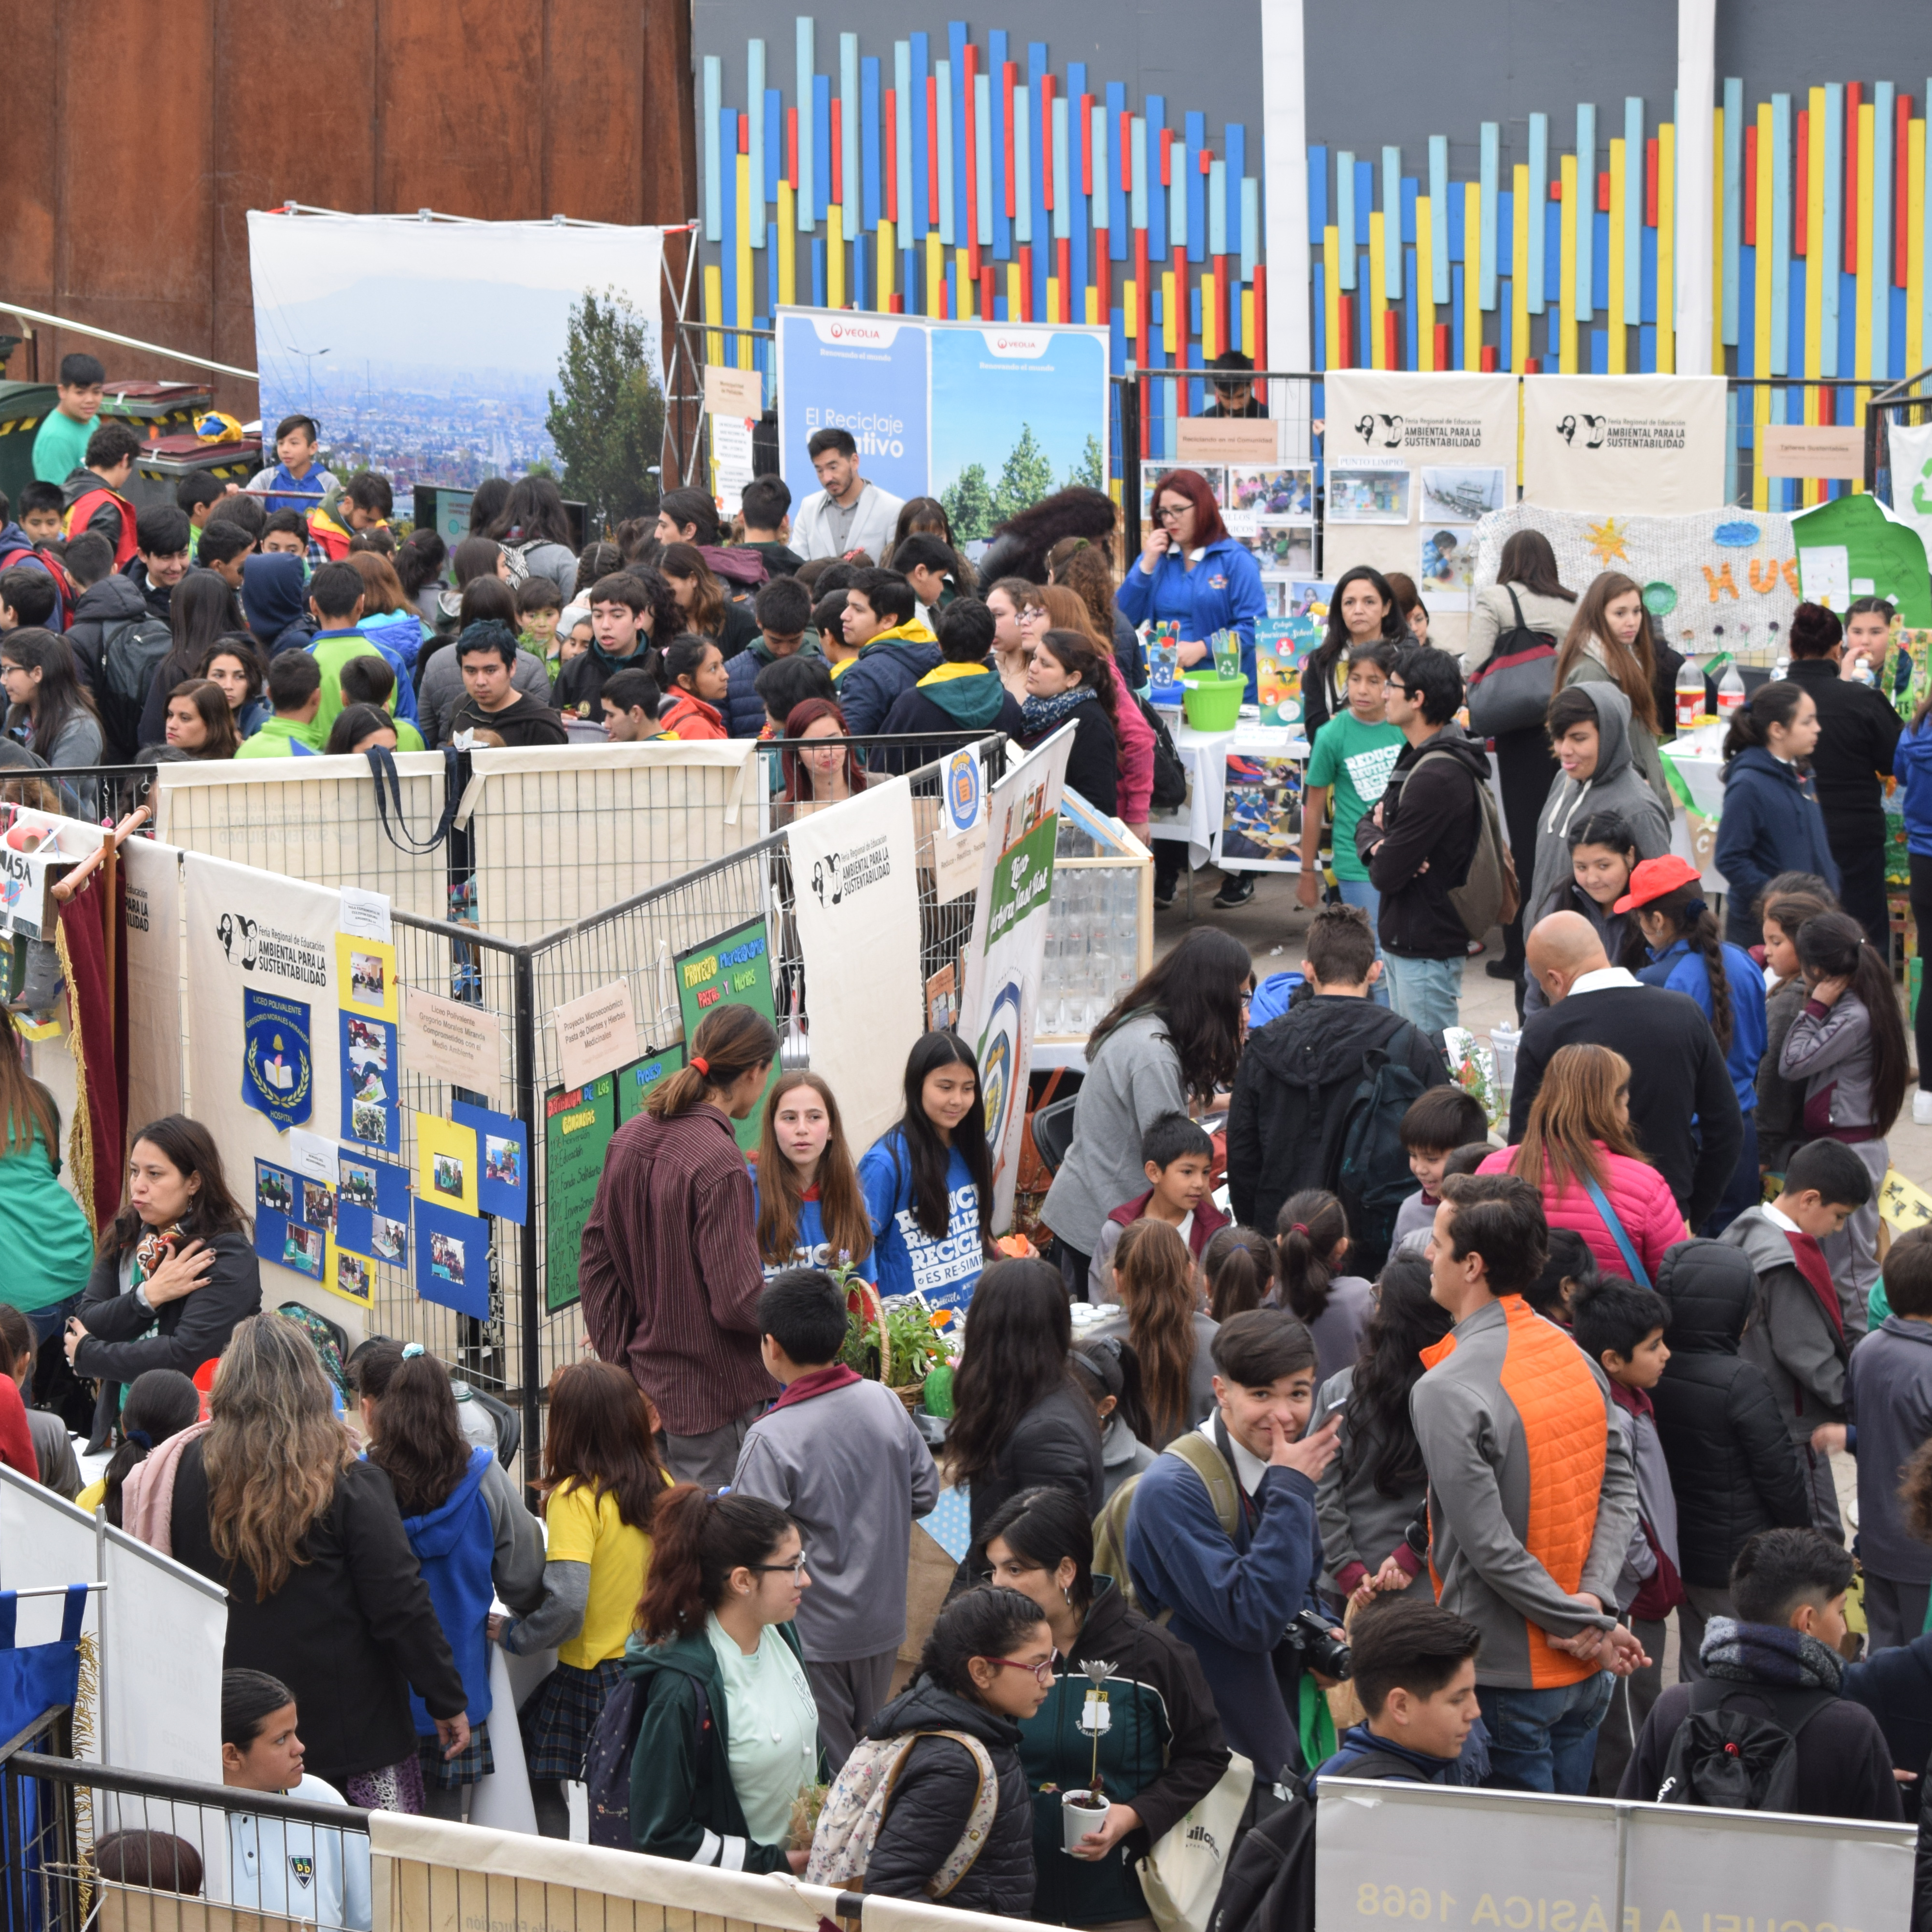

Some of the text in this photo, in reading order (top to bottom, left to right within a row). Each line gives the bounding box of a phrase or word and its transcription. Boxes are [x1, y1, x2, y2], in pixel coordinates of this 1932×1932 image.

[845, 328, 880, 339] VEOLIA
[820, 348, 858, 359] Renovando
[980, 361, 1019, 370] Renovando
[806, 407, 903, 437] El Reciclaje
[1405, 427, 1481, 437] AMBIENTAL PARA LA
[1607, 427, 1685, 438] AMBIENTAL PARA LA
[1623, 418, 1648, 426] Regional
[1405, 437, 1481, 447] SUSTENTABILIDAD
[1606, 438, 1685, 448] SUSTENTABILIDAD
[841, 834, 887, 863] Feria Regional de Educación
[843, 847, 889, 881] AMBIENTAL PARA LA
[844, 862, 890, 896] SUSTENTABILIDAD
[127, 883, 148, 899] Educación
[141, 902, 148, 917] LA
[259, 925, 325, 952] Feria Regional de Educación
[259, 940, 326, 971] AMBIENTAL PARA LA
[259, 956, 326, 987] SUSTENTABILIDAD
[684, 955, 717, 989] PROYECTO
[723, 980, 728, 995] Y
[253, 995, 301, 1016] LICEO POLIVALENTE
[431, 1005, 475, 1026] Liceo Polivalente
[564, 999, 623, 1031] Proyecto Microeconómico
[246, 1013, 309, 1045] GREGORIO MORALES MIRANDA
[419, 1012, 485, 1041] Gregorio Morales Miranda
[423, 1024, 464, 1045] Comprometidos
[465, 1040, 475, 1049] con
[565, 1011, 626, 1044] Pasta de Dientes y Hierbas
[432, 1039, 474, 1060] Medio Ambiente
[584, 1031, 612, 1049] Medicinales
[270, 1110, 294, 1123] HOSPITAL
[926, 1270, 941, 1284] ES
